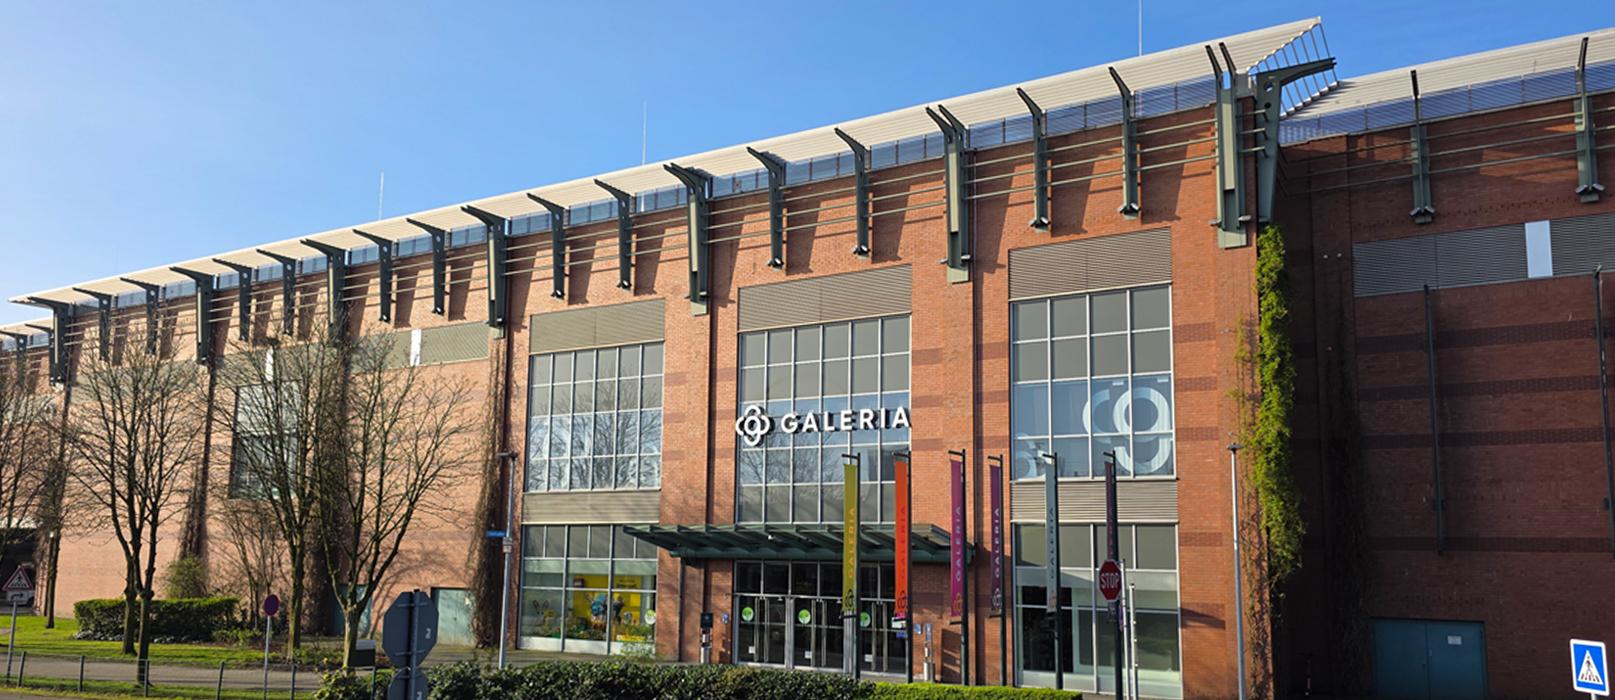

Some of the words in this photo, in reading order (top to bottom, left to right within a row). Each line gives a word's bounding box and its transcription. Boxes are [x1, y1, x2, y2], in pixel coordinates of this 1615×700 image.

[780, 406, 910, 433] GALERIA
[847, 507, 855, 579] GALERIA
[1100, 573, 1120, 589] STOP
